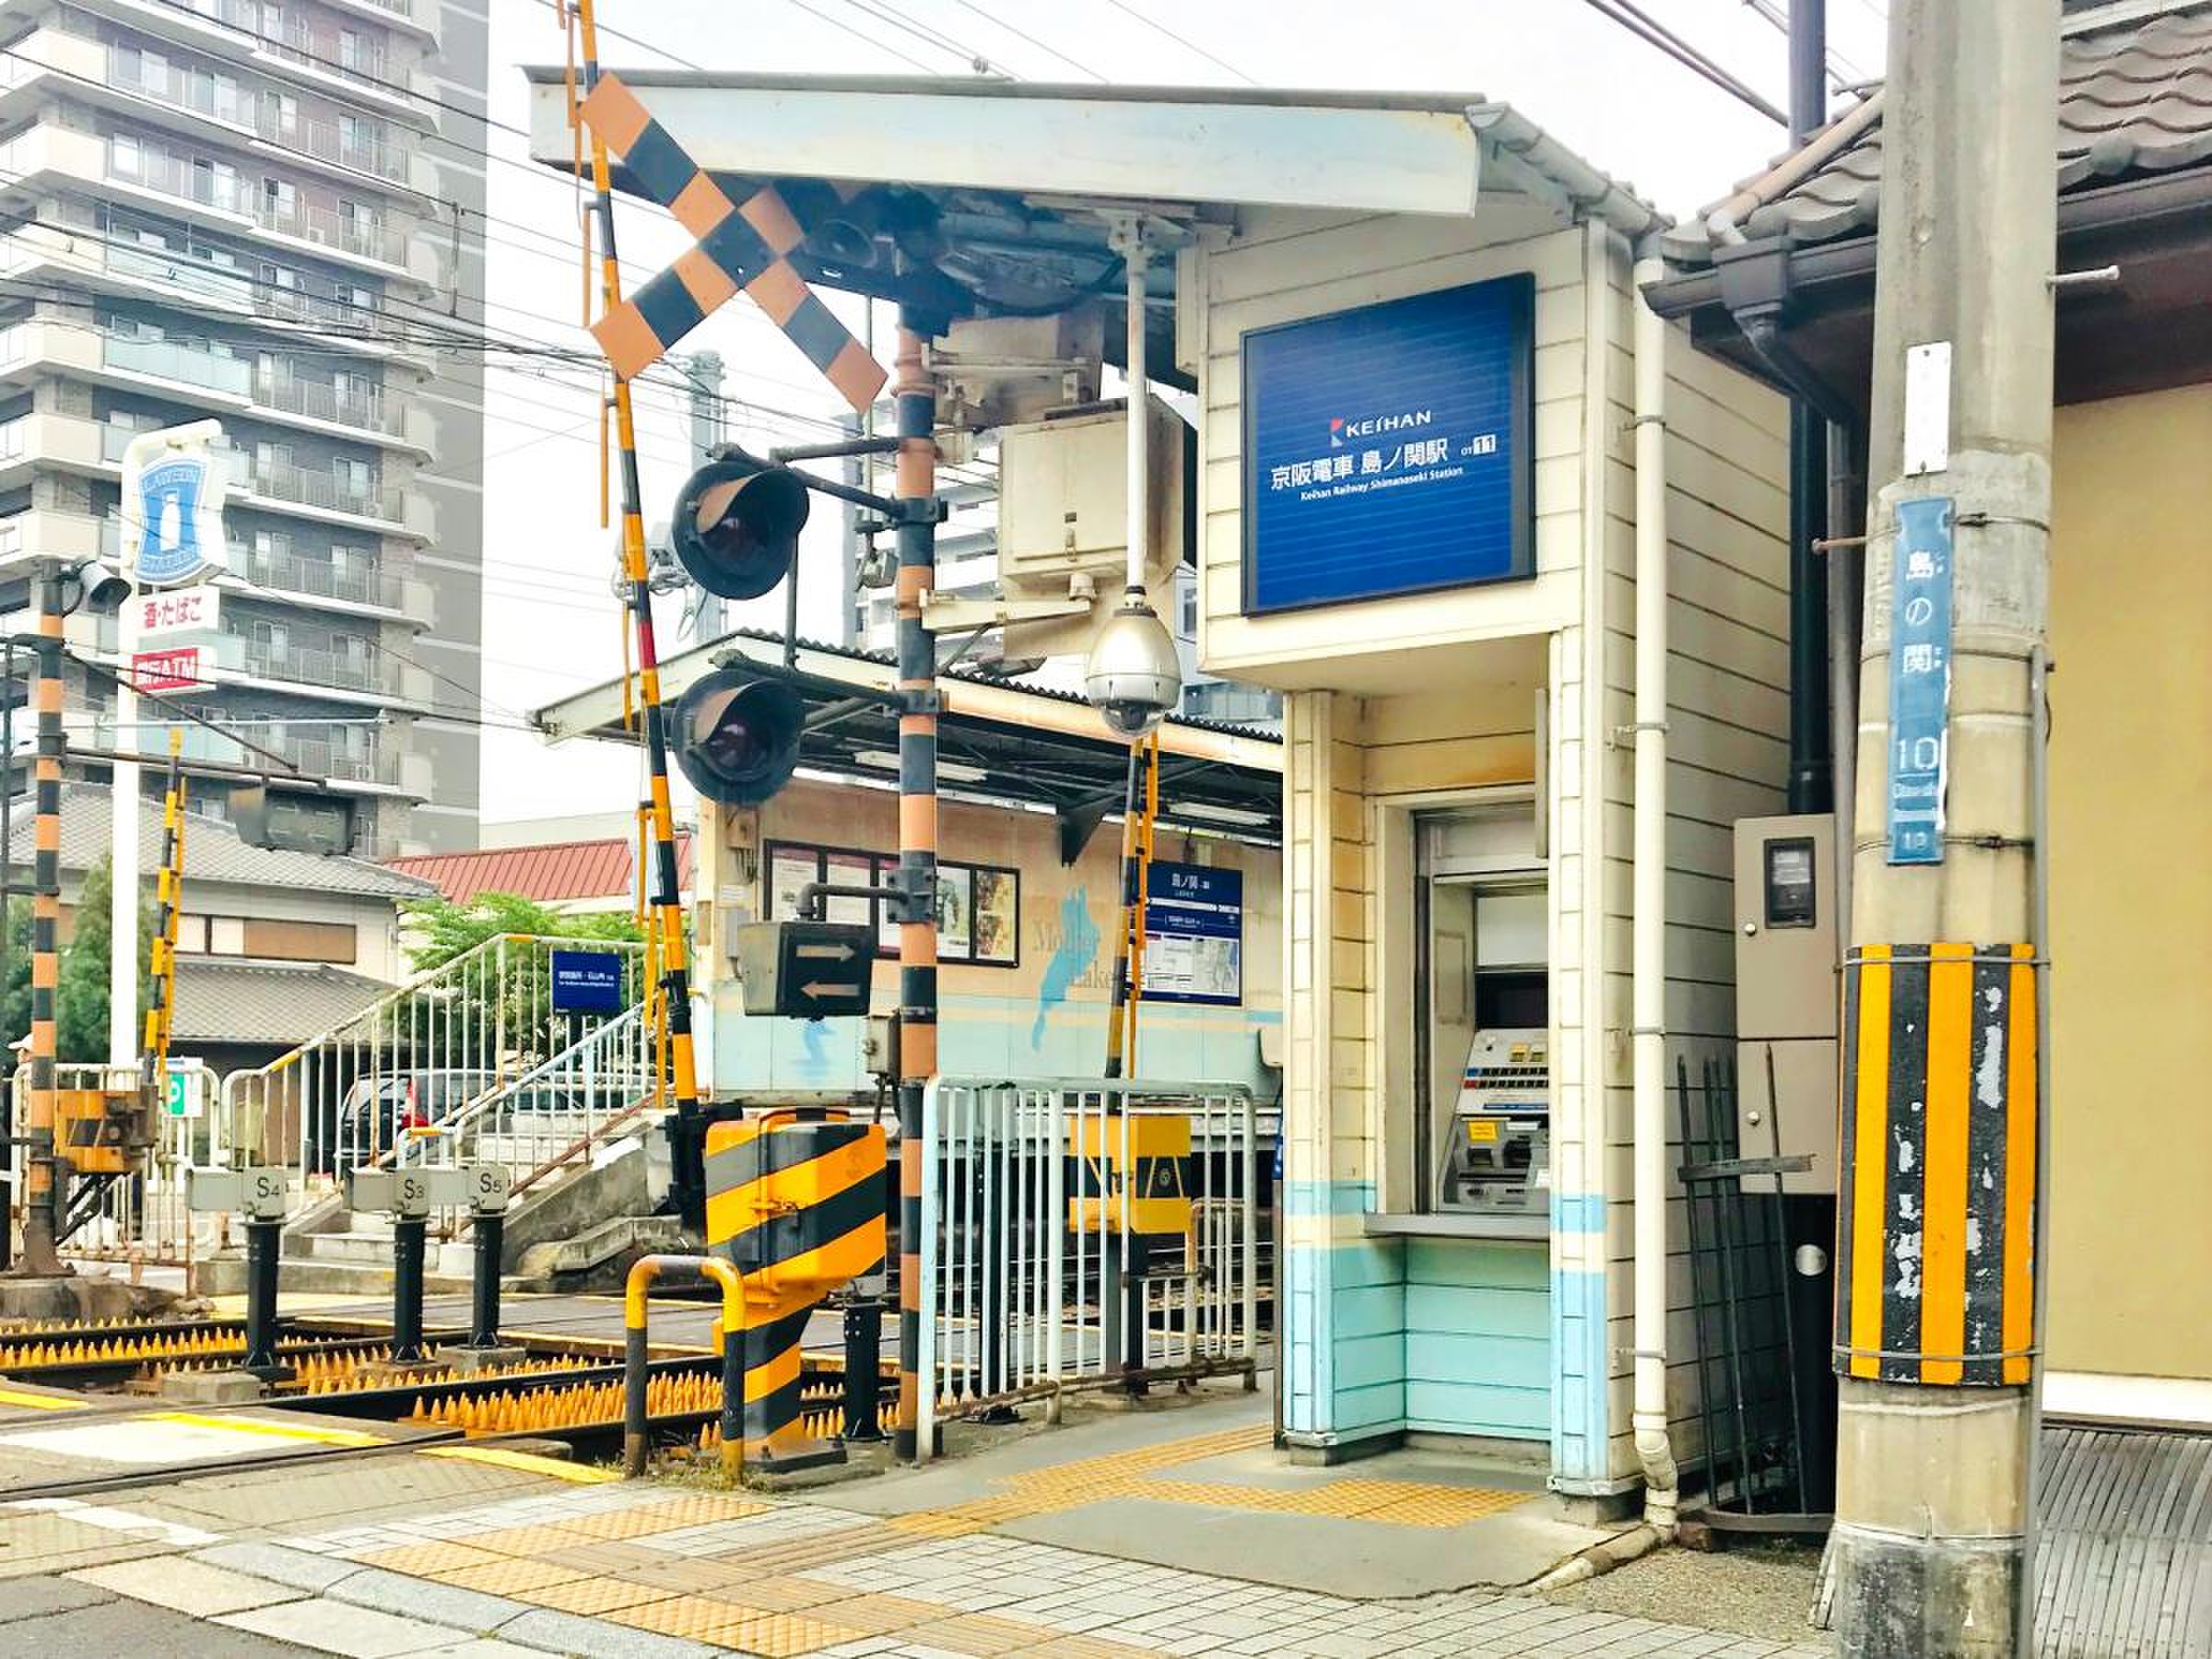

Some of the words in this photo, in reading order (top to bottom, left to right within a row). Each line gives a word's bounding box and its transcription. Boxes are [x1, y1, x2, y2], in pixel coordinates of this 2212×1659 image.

[1347, 410, 1431, 438] KEIHAN
[1271, 454, 1354, 490] 京阪電車
[1361, 437, 1448, 475] 島ノ関駅
[1430, 466, 1464, 480] Station
[1899, 736, 1939, 771] 10
[256, 1177, 280, 1198] S4
[404, 1179, 425, 1199] S3
[479, 1172, 502, 1193] S5
